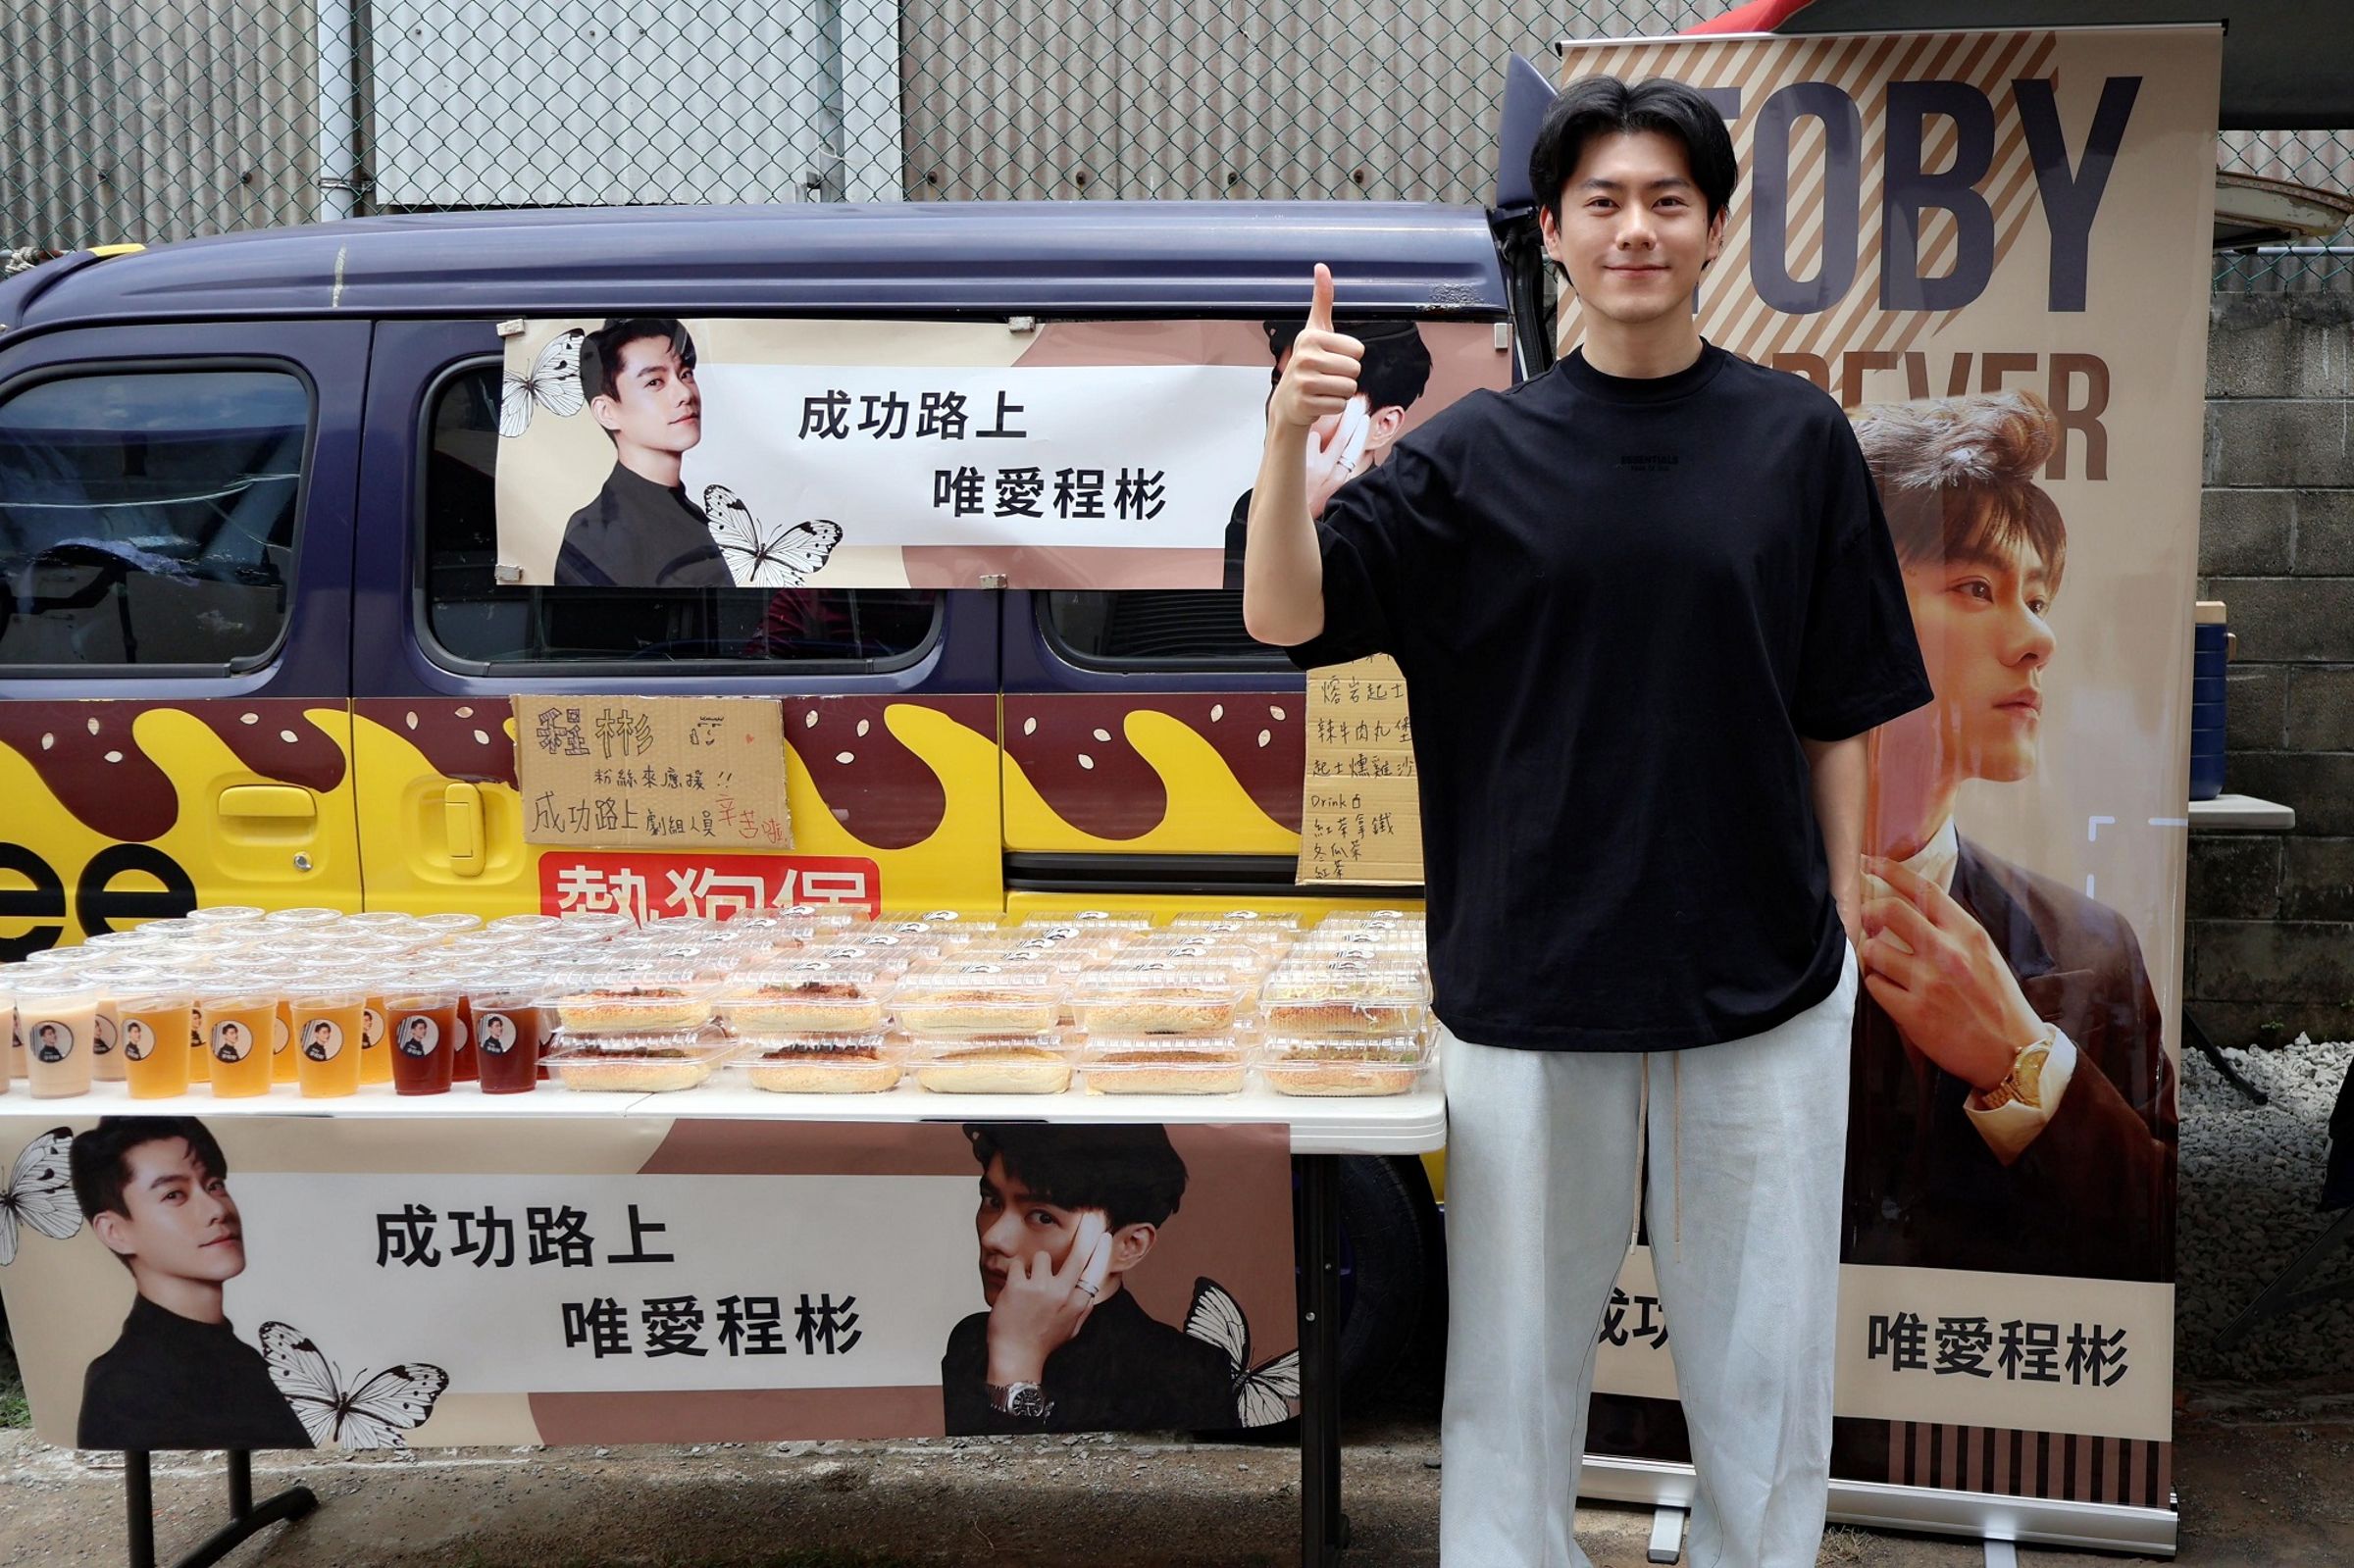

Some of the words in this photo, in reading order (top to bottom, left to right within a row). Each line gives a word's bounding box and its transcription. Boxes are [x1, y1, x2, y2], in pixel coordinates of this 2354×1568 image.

[1692, 76, 2143, 315] OBY
[797, 389, 1028, 440] 成功路上
[933, 466, 1167, 521] 唯愛程彬
[537, 707, 653, 759] 程彬
[1310, 793, 1347, 809] Drink
[376, 1203, 676, 1268] 成功路上
[561, 1293, 863, 1359] 唯愛程彬
[1868, 1311, 2129, 1388] 唯愛程彬
